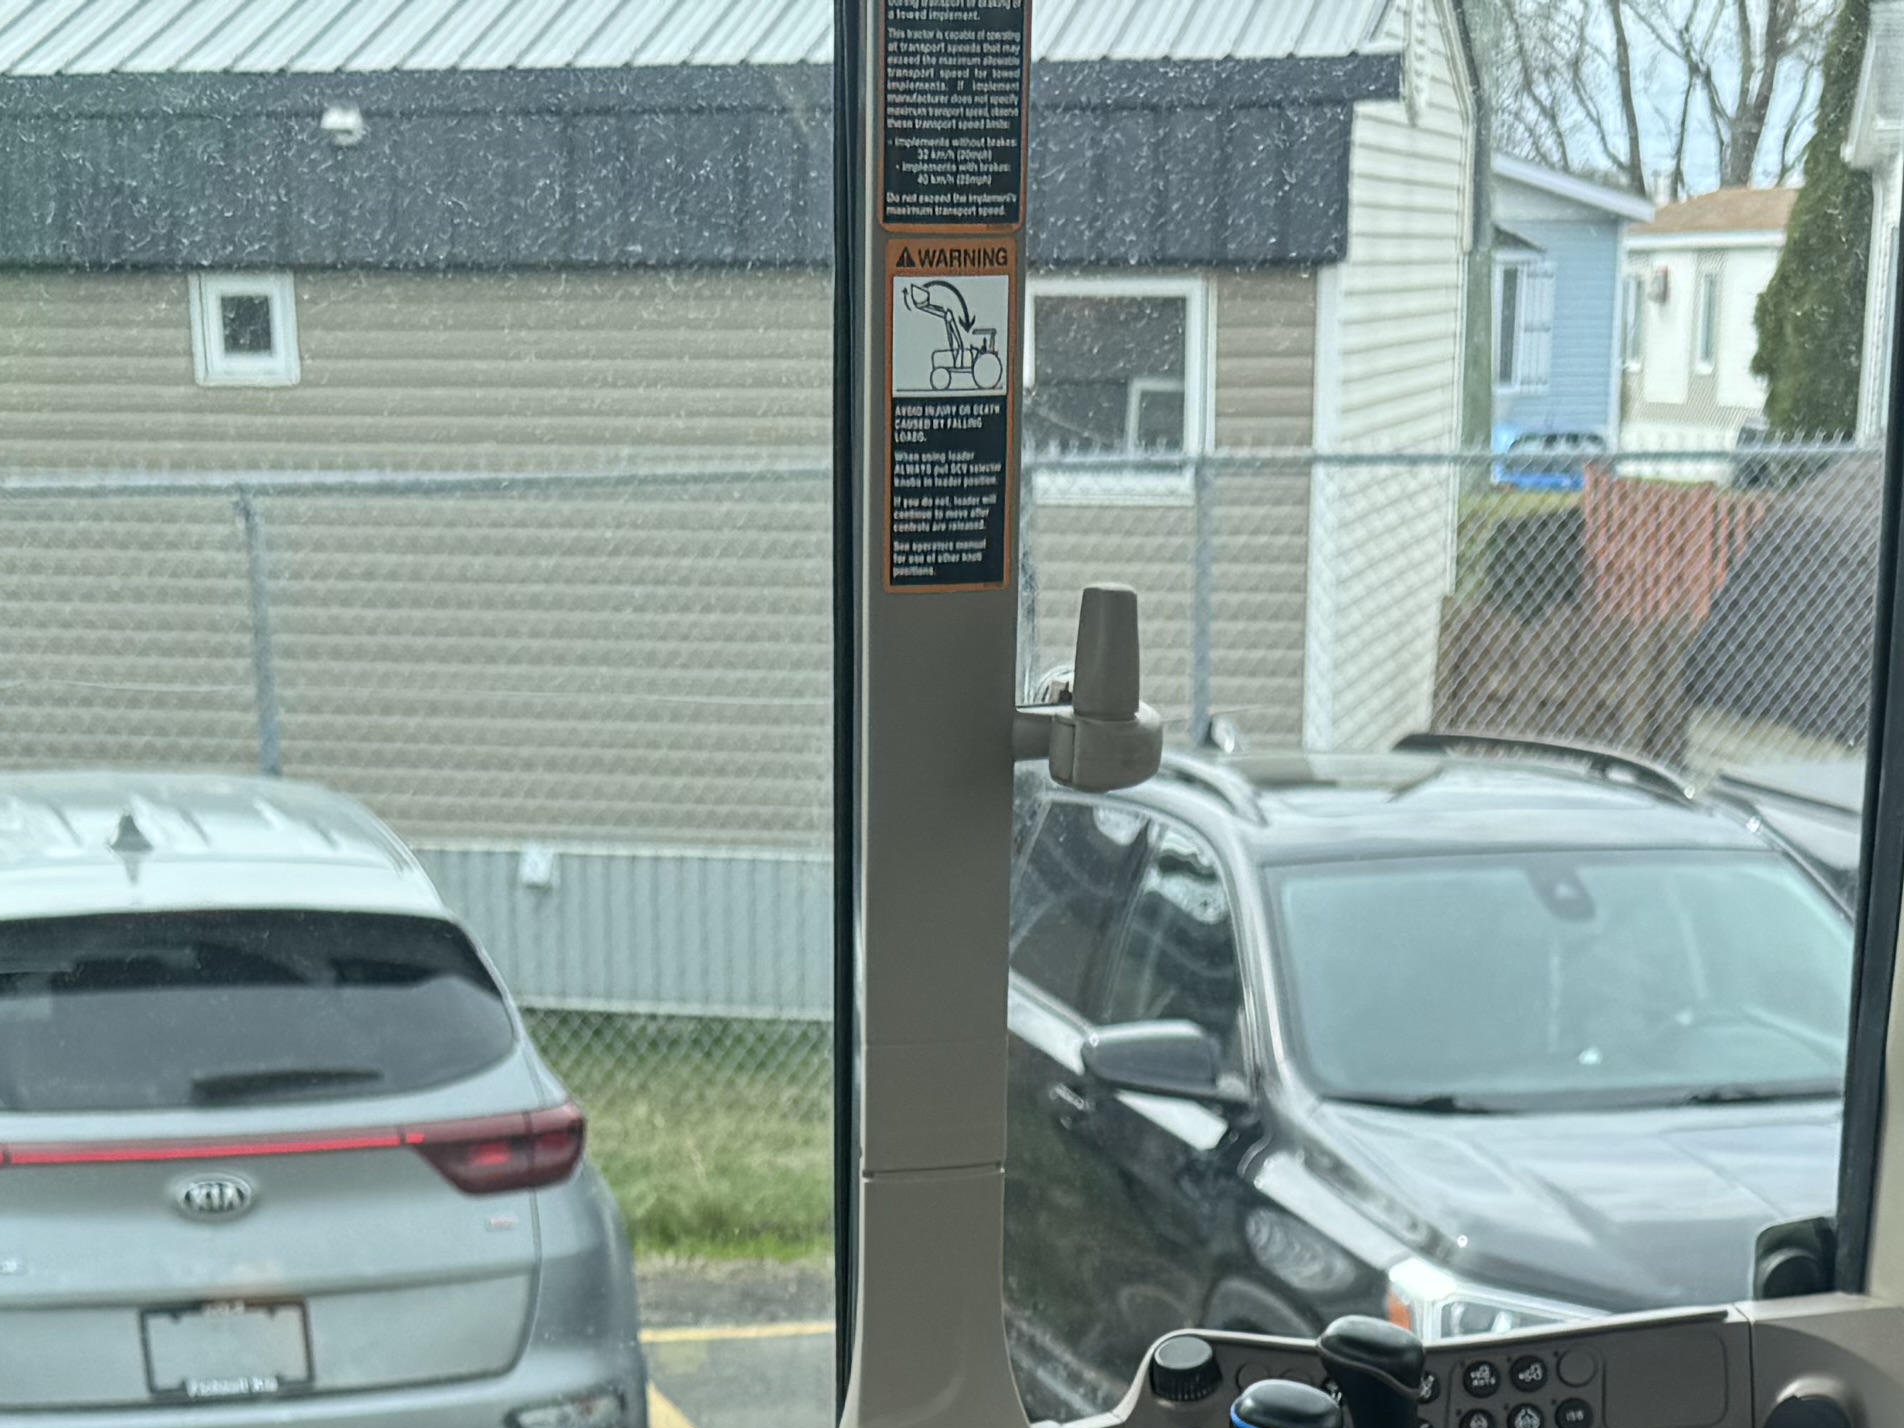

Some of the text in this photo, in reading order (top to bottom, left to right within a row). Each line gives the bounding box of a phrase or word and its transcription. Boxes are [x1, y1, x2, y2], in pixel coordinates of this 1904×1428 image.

[888, 9, 980, 20] a towed implement.
[888, 28, 1020, 42] This tractor is capable of operating
[888, 42, 1020, 55] at transport speeds that may
[887, 55, 1020, 65] exceed the maximum allowable
[887, 68, 1020, 79] transport speed for towed
[887, 80, 1019, 92] implements. If implement
[887, 93, 1018, 105] manufacturer does not specify
[887, 107, 927, 116] maximum
[929, 107, 963, 117] transport
[991, 107, 1018, 116] observe
[887, 118, 913, 128] these
[915, 119, 956, 130] transport
[958, 119, 984, 130] speed
[895, 137, 949, 148] Implements
[952, 138, 984, 147] without
[918, 149, 929, 160] 32
[931, 149, 954, 159] km/h
[902, 162, 956, 173] Implements
[959, 162, 977, 172] with
[918, 174, 929, 185] 40
[931, 174, 954, 184] km/h
[887, 192, 899, 202] Do
[902, 194, 916, 202] not
[919, 194, 950, 203] exceed
[953, 193, 966, 203] the
[886, 205, 1006, 216] maximum transport speed.
[918, 247, 1007, 268] WARNING
[895, 404, 1000, 416] AVOID INJURY OR DEATH
[895, 417, 982, 429] CAUSED BY FALLING
[894, 431, 927, 442] LOADS.
[894, 451, 975, 463] When using loader
[894, 464, 931, 474] ALWAYS
[934, 464, 948, 476] put
[951, 463, 967, 474] SCV
[924, 477, 932, 487] in
[935, 476, 961, 487] loader
[894, 494, 996, 508] If you do not, loader will
[894, 508, 989, 519] continue to move after
[893, 519, 986, 532] controls are released.
[893, 541, 910, 551] See
[956, 538, 986, 550] manual
[893, 552, 982, 564] for use of other knob
[893, 566, 936, 577] positions.
[184, 1183, 245, 1213] KIA
